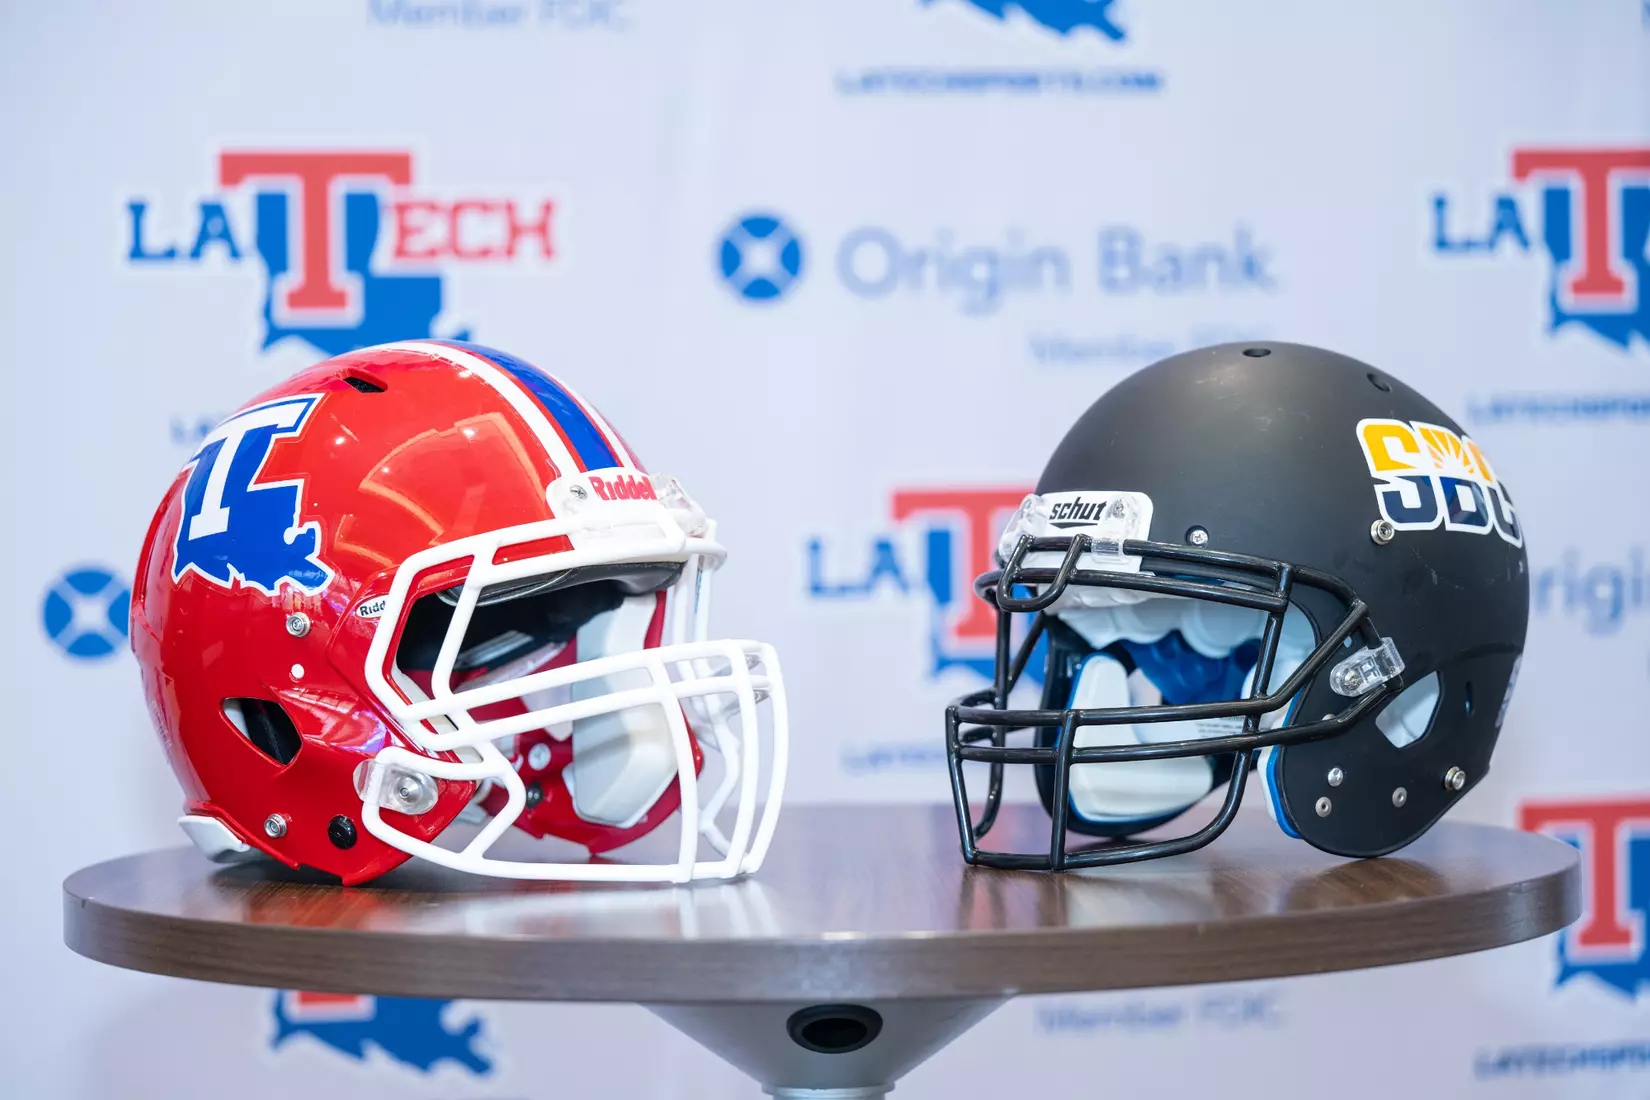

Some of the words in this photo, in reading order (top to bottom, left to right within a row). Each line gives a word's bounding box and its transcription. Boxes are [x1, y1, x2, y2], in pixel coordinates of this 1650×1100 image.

[836, 225, 1072, 317] Origin
[1098, 220, 1276, 295] Bank
[588, 475, 658, 501] Riddel
[1049, 496, 1108, 521] schut
[1536, 546, 1650, 637] rigi
[359, 600, 387, 617] Ridd
